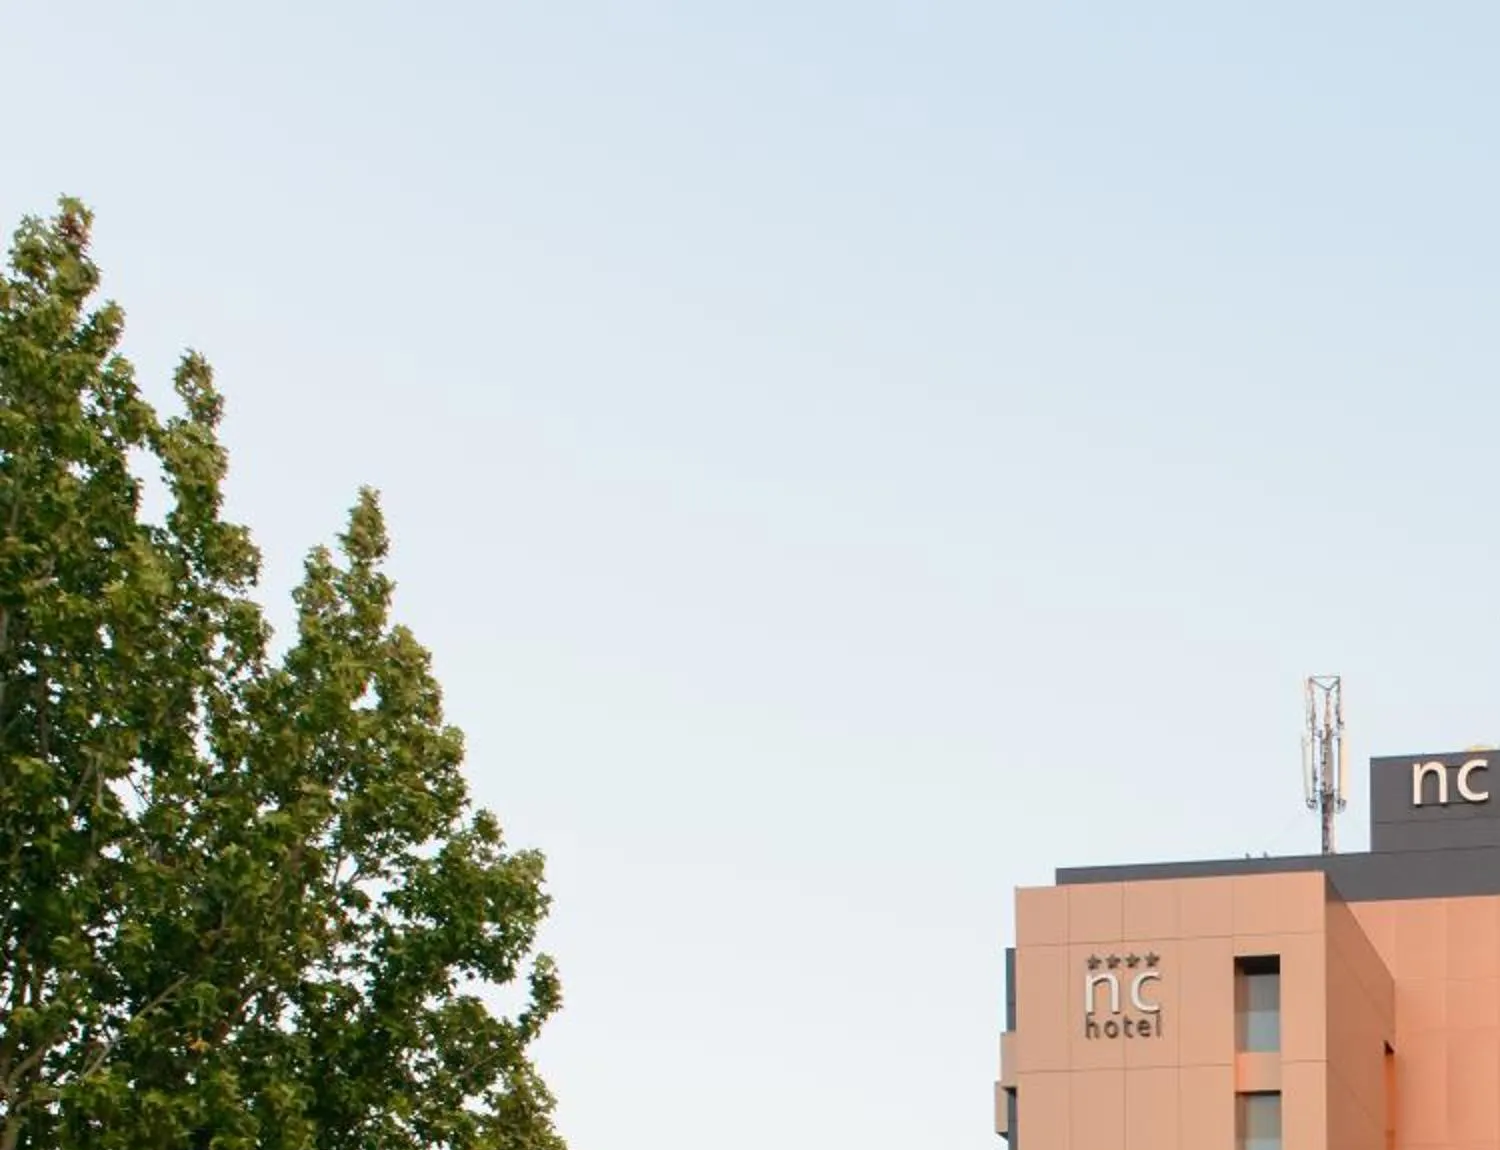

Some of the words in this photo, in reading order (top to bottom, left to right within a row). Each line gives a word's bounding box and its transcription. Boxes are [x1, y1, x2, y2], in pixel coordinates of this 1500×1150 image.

[1412, 758, 1490, 806] nc
[1085, 970, 1161, 1014] nc
[1085, 1014, 1162, 1039] hotel
